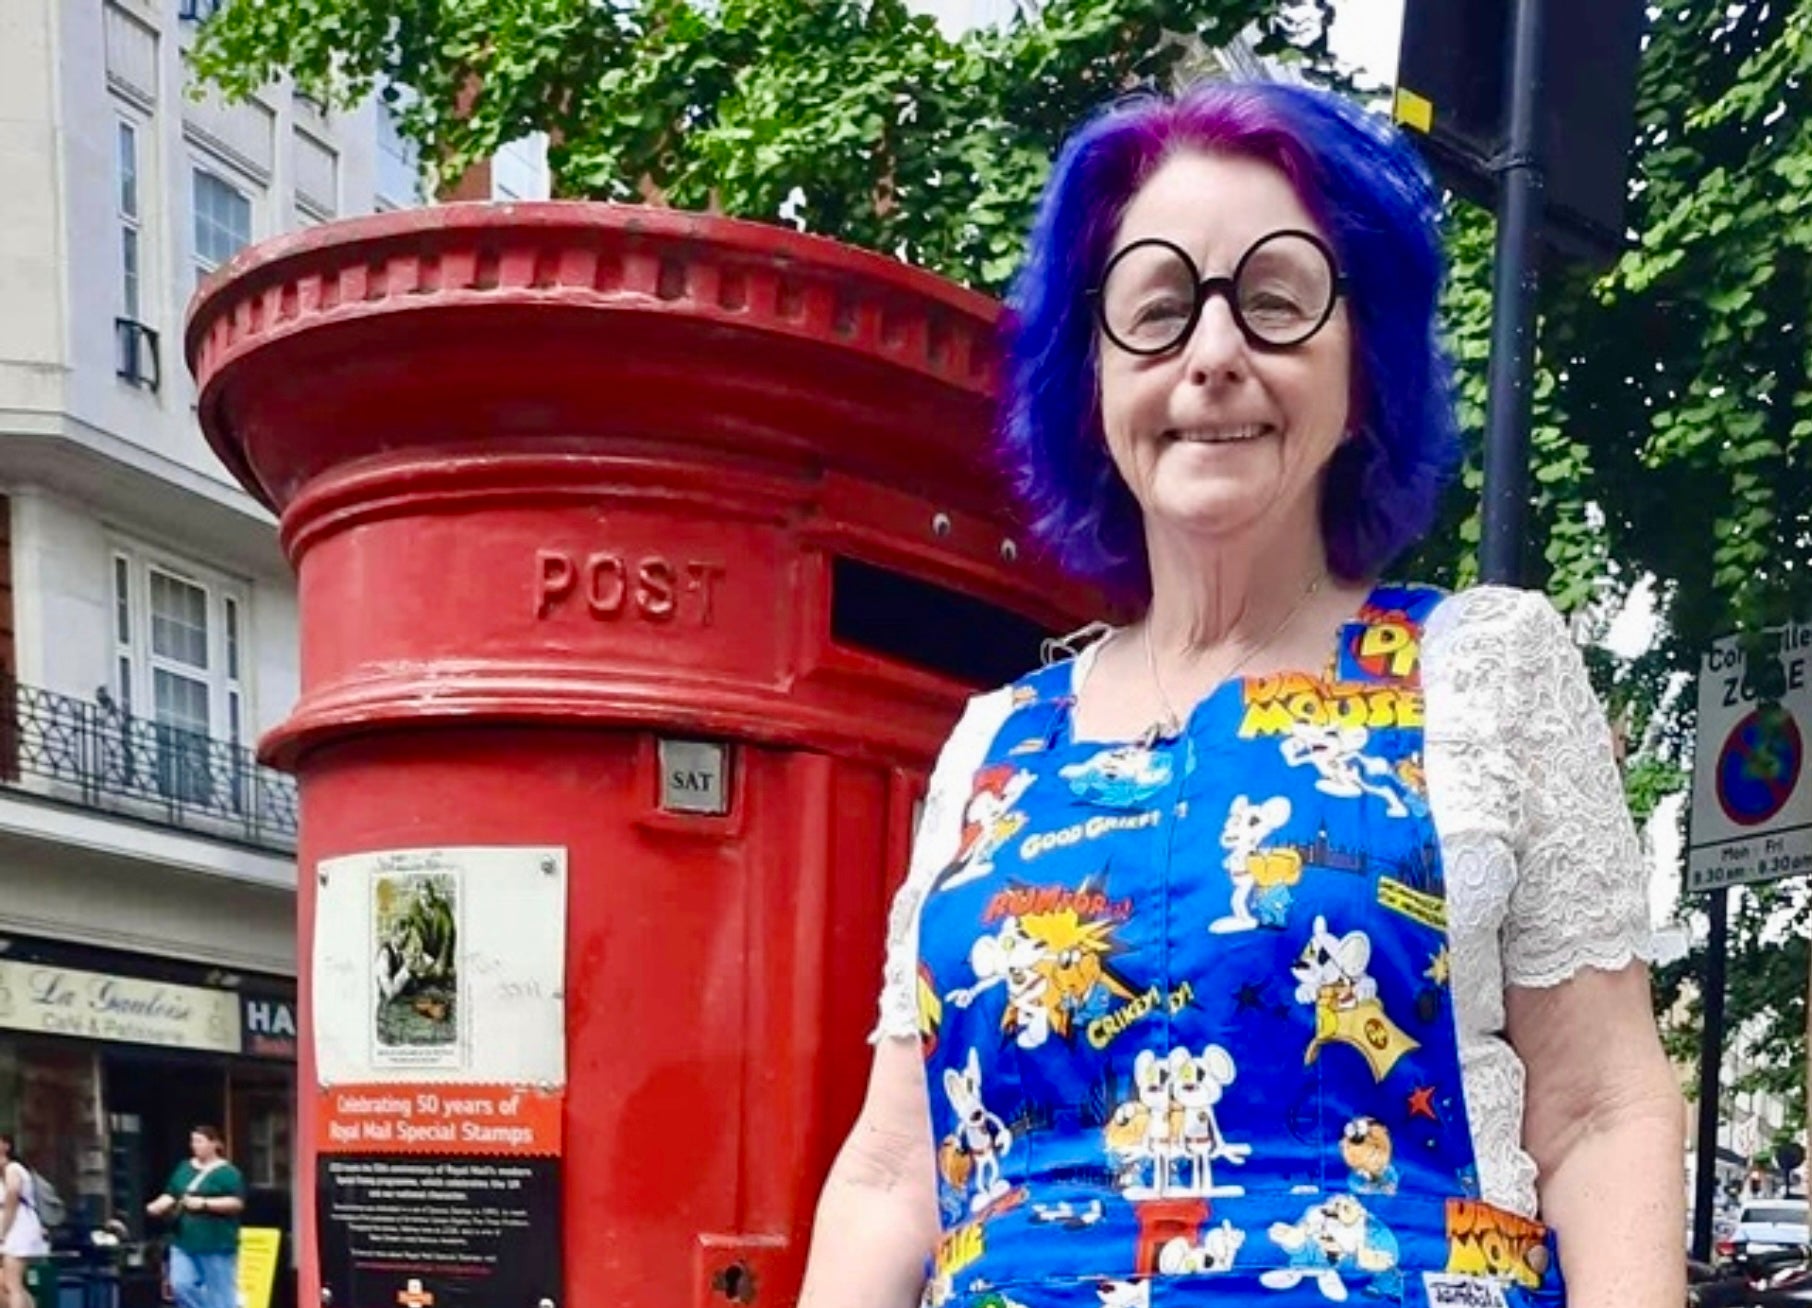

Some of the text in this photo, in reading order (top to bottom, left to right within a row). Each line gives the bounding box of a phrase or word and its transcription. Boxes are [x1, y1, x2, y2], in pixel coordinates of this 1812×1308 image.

[534, 549, 727, 627] POST
[1723, 658, 1805, 707] ZOE
[671, 771, 714, 792] SAT
[1019, 825, 1084, 861] GOOD
[416, 1093, 440, 1113] 50
[443, 1098, 494, 1118] years
[498, 1094, 522, 1116] of
[396, 1120, 457, 1143] Special
[461, 1121, 535, 1146] Stamps
